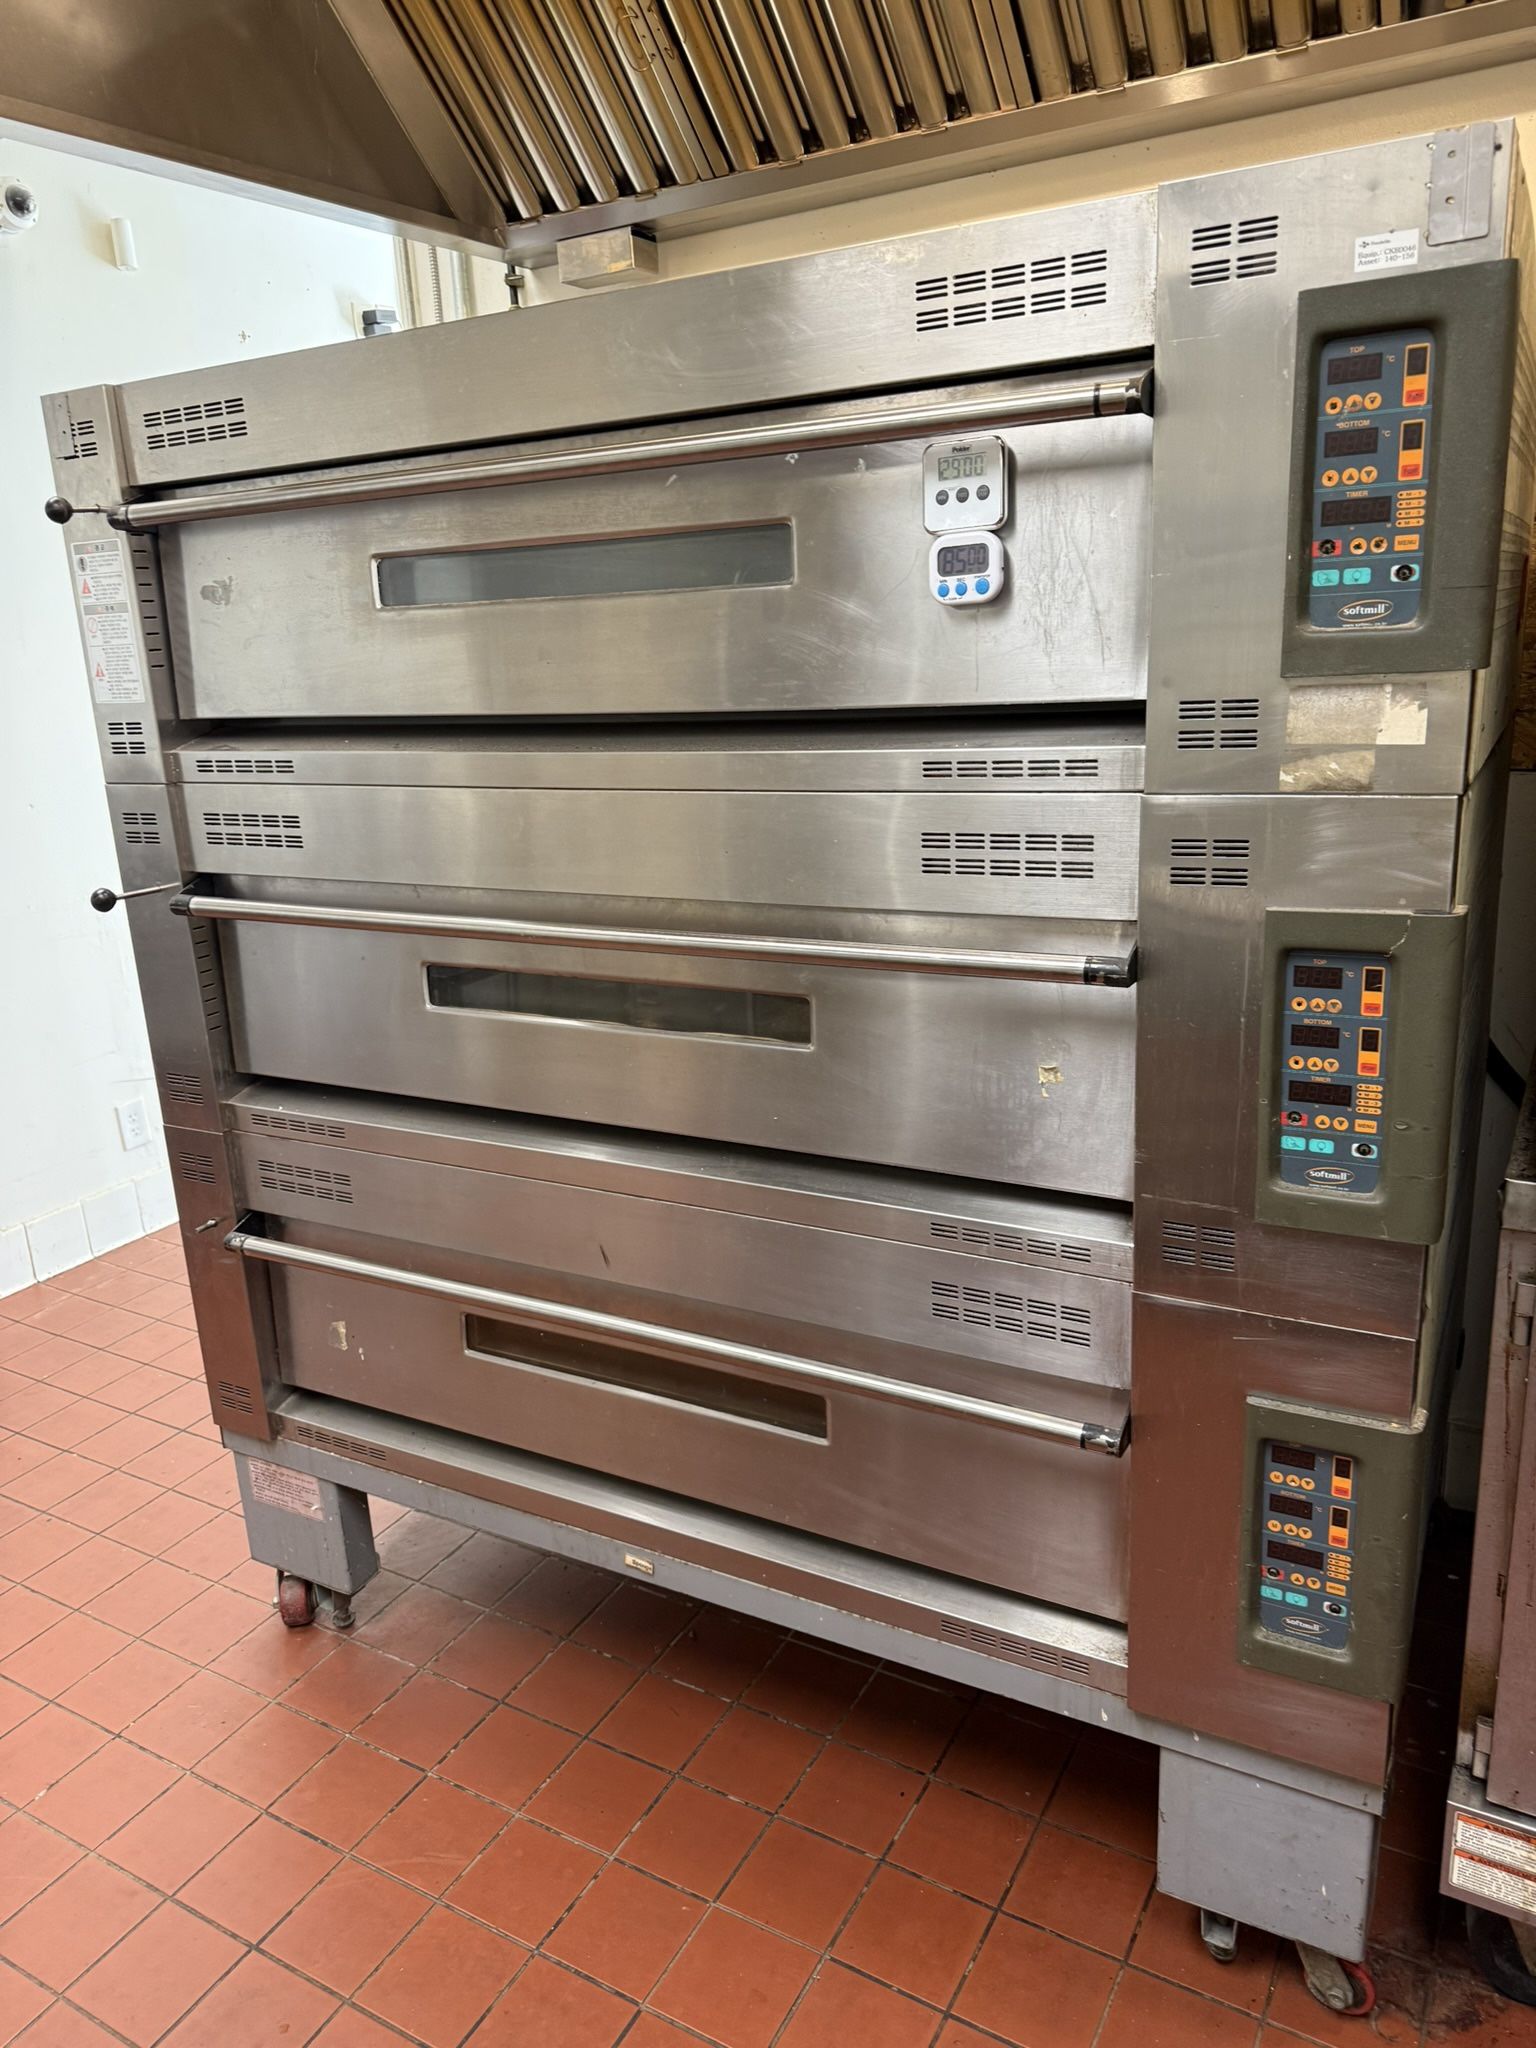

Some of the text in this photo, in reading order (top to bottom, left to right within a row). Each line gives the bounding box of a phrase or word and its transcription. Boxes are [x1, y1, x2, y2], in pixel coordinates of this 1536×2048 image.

[1350, 345, 1365, 353] TOP
[1338, 420, 1370, 429] BOTTOM
[1345, 490, 1369, 498] TIMER
[1343, 603, 1385, 615] softmill
[1310, 1170, 1347, 1180] softmill
